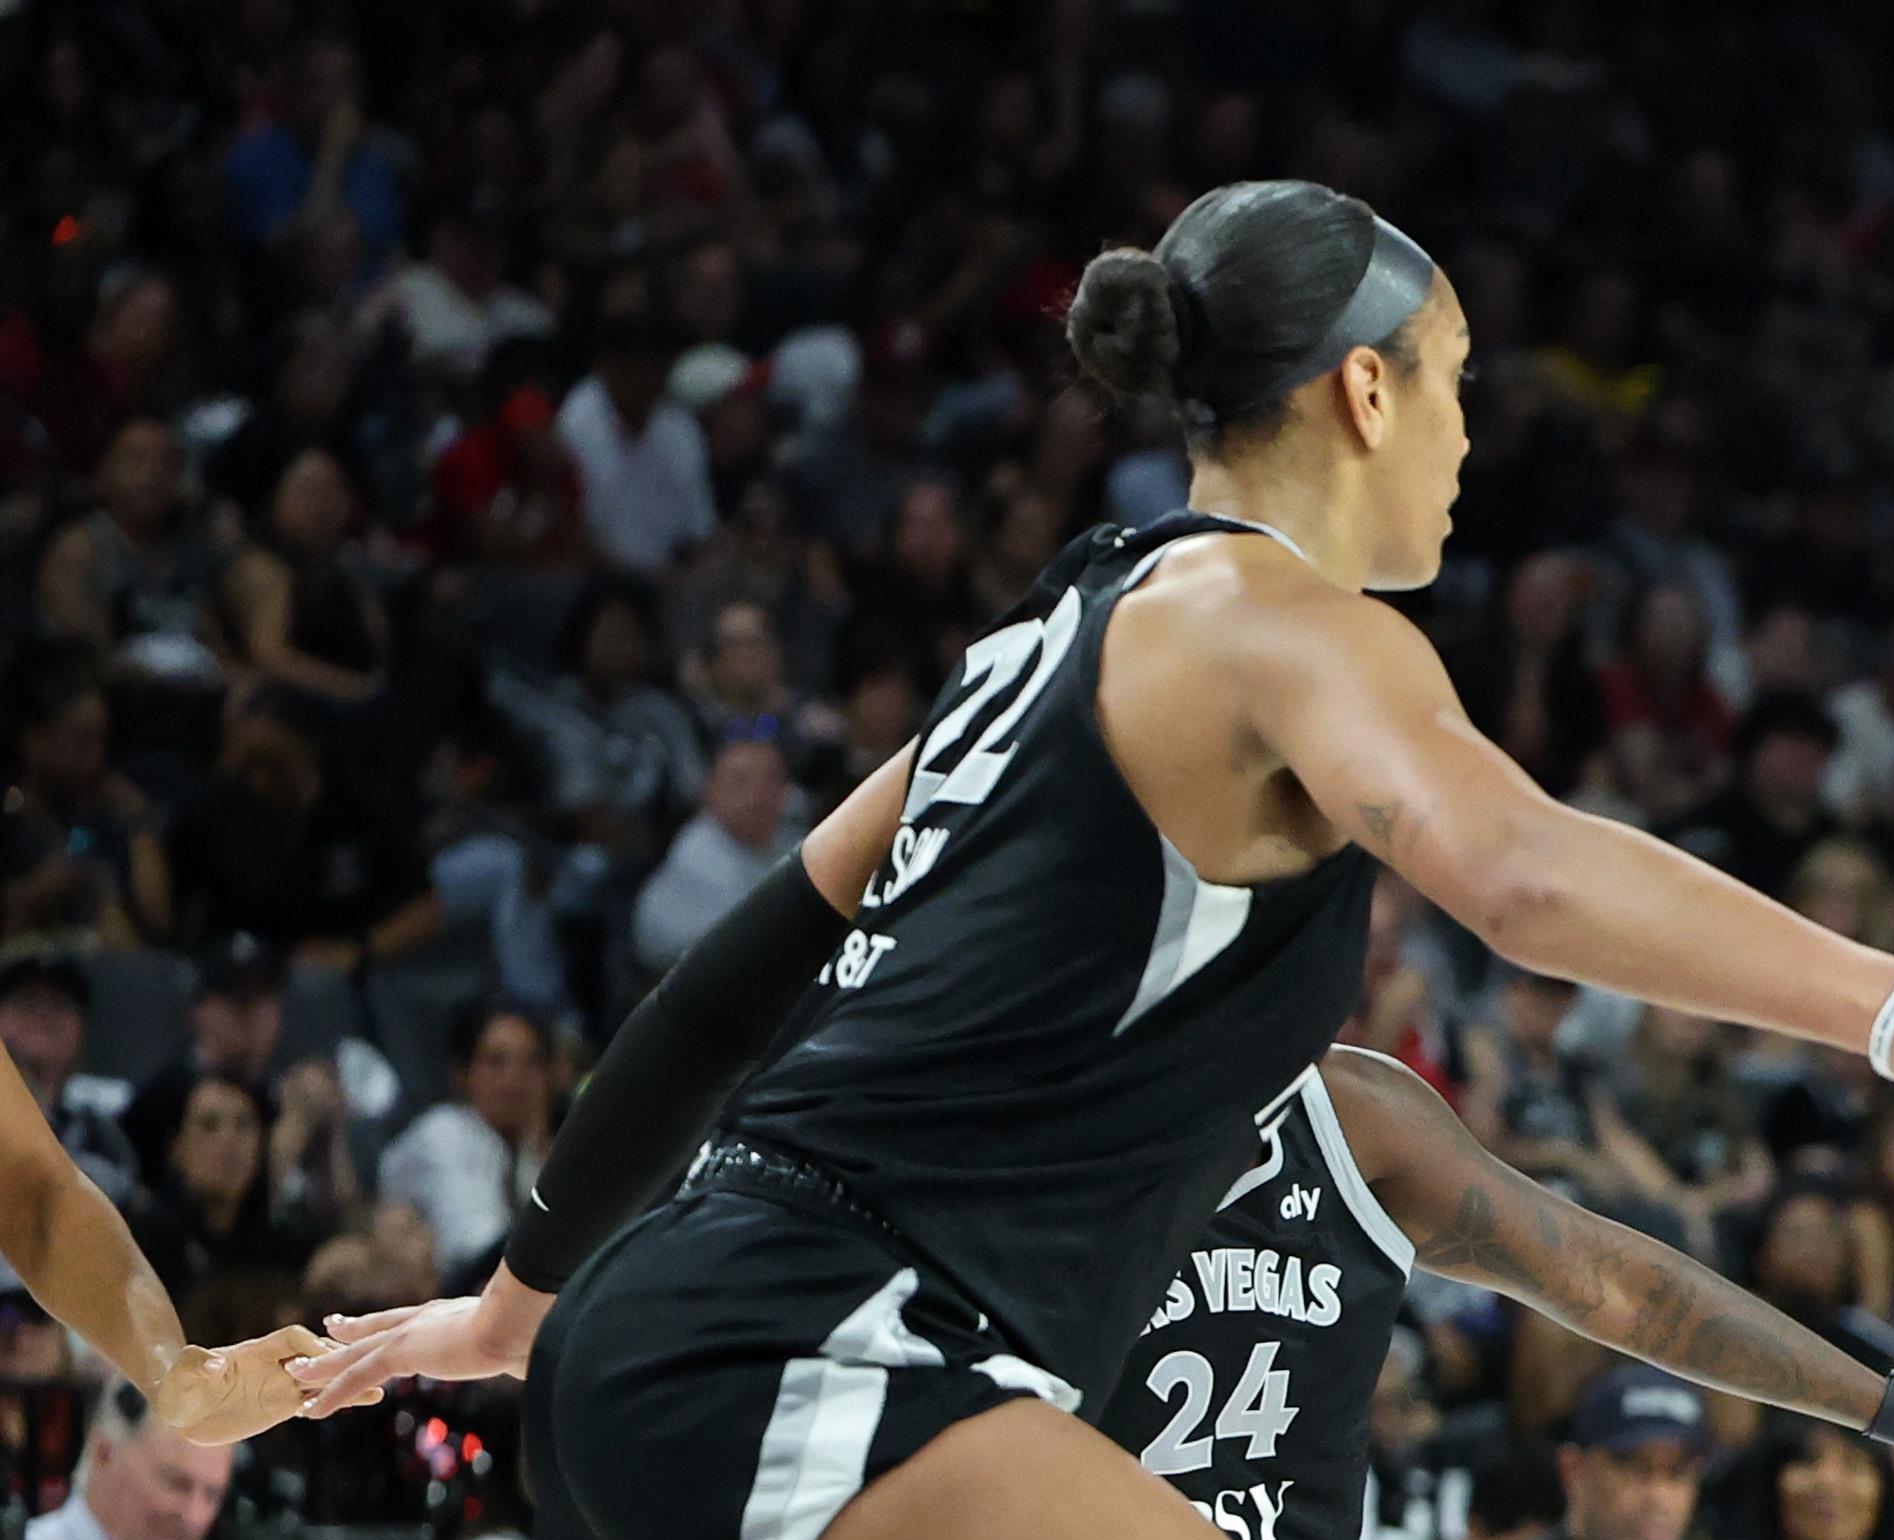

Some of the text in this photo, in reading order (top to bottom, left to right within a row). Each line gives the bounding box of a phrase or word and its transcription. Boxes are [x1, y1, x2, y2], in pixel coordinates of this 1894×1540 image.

[814, 928, 898, 989] &T
[1191, 1248, 1342, 1327] VEGAS
[1140, 1341, 1300, 1476] 24
